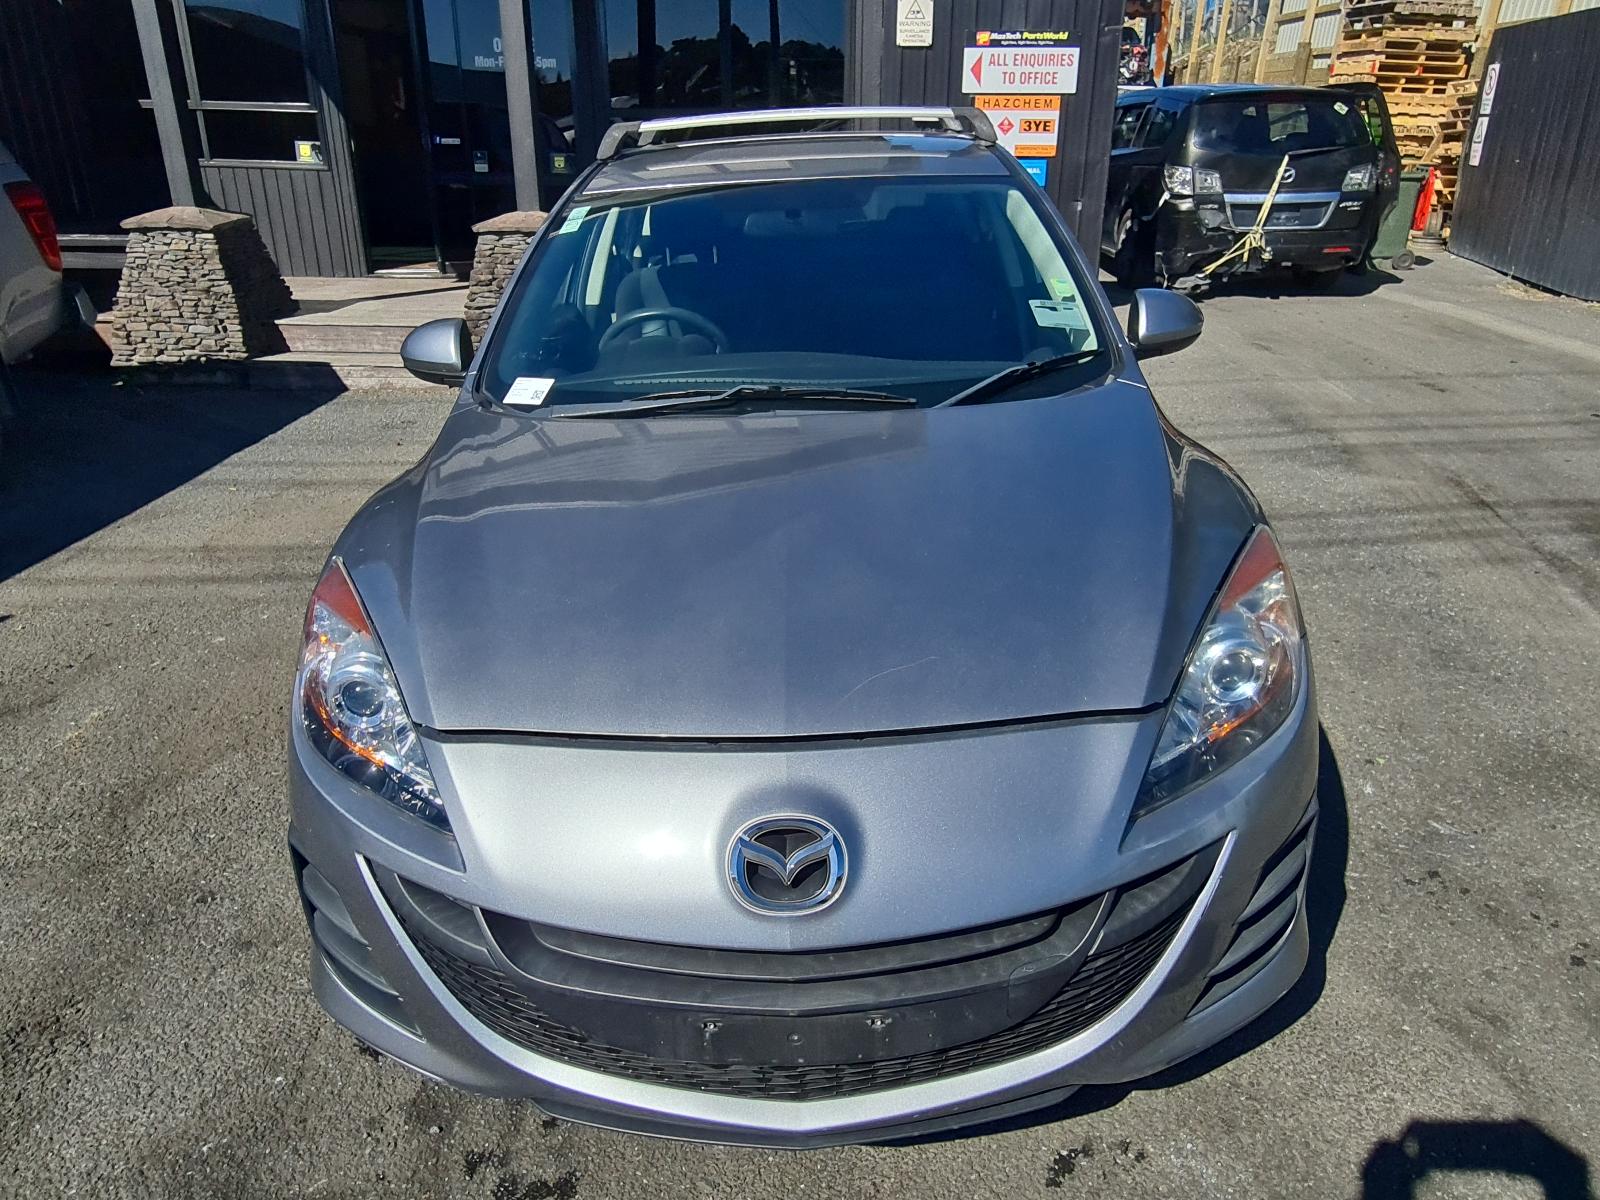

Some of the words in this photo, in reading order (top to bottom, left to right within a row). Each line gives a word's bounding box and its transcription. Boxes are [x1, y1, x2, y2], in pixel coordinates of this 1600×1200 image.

[474, 55, 504, 68] Mon-F
[988, 53, 1009, 67] ALL
[1013, 53, 1075, 68] ENQUIRIES
[1002, 71, 1016, 85] TO
[1019, 71, 1059, 85] OFFICE
[982, 98, 1053, 108] HAZCHEM
[1023, 120, 1052, 132] 3YE
